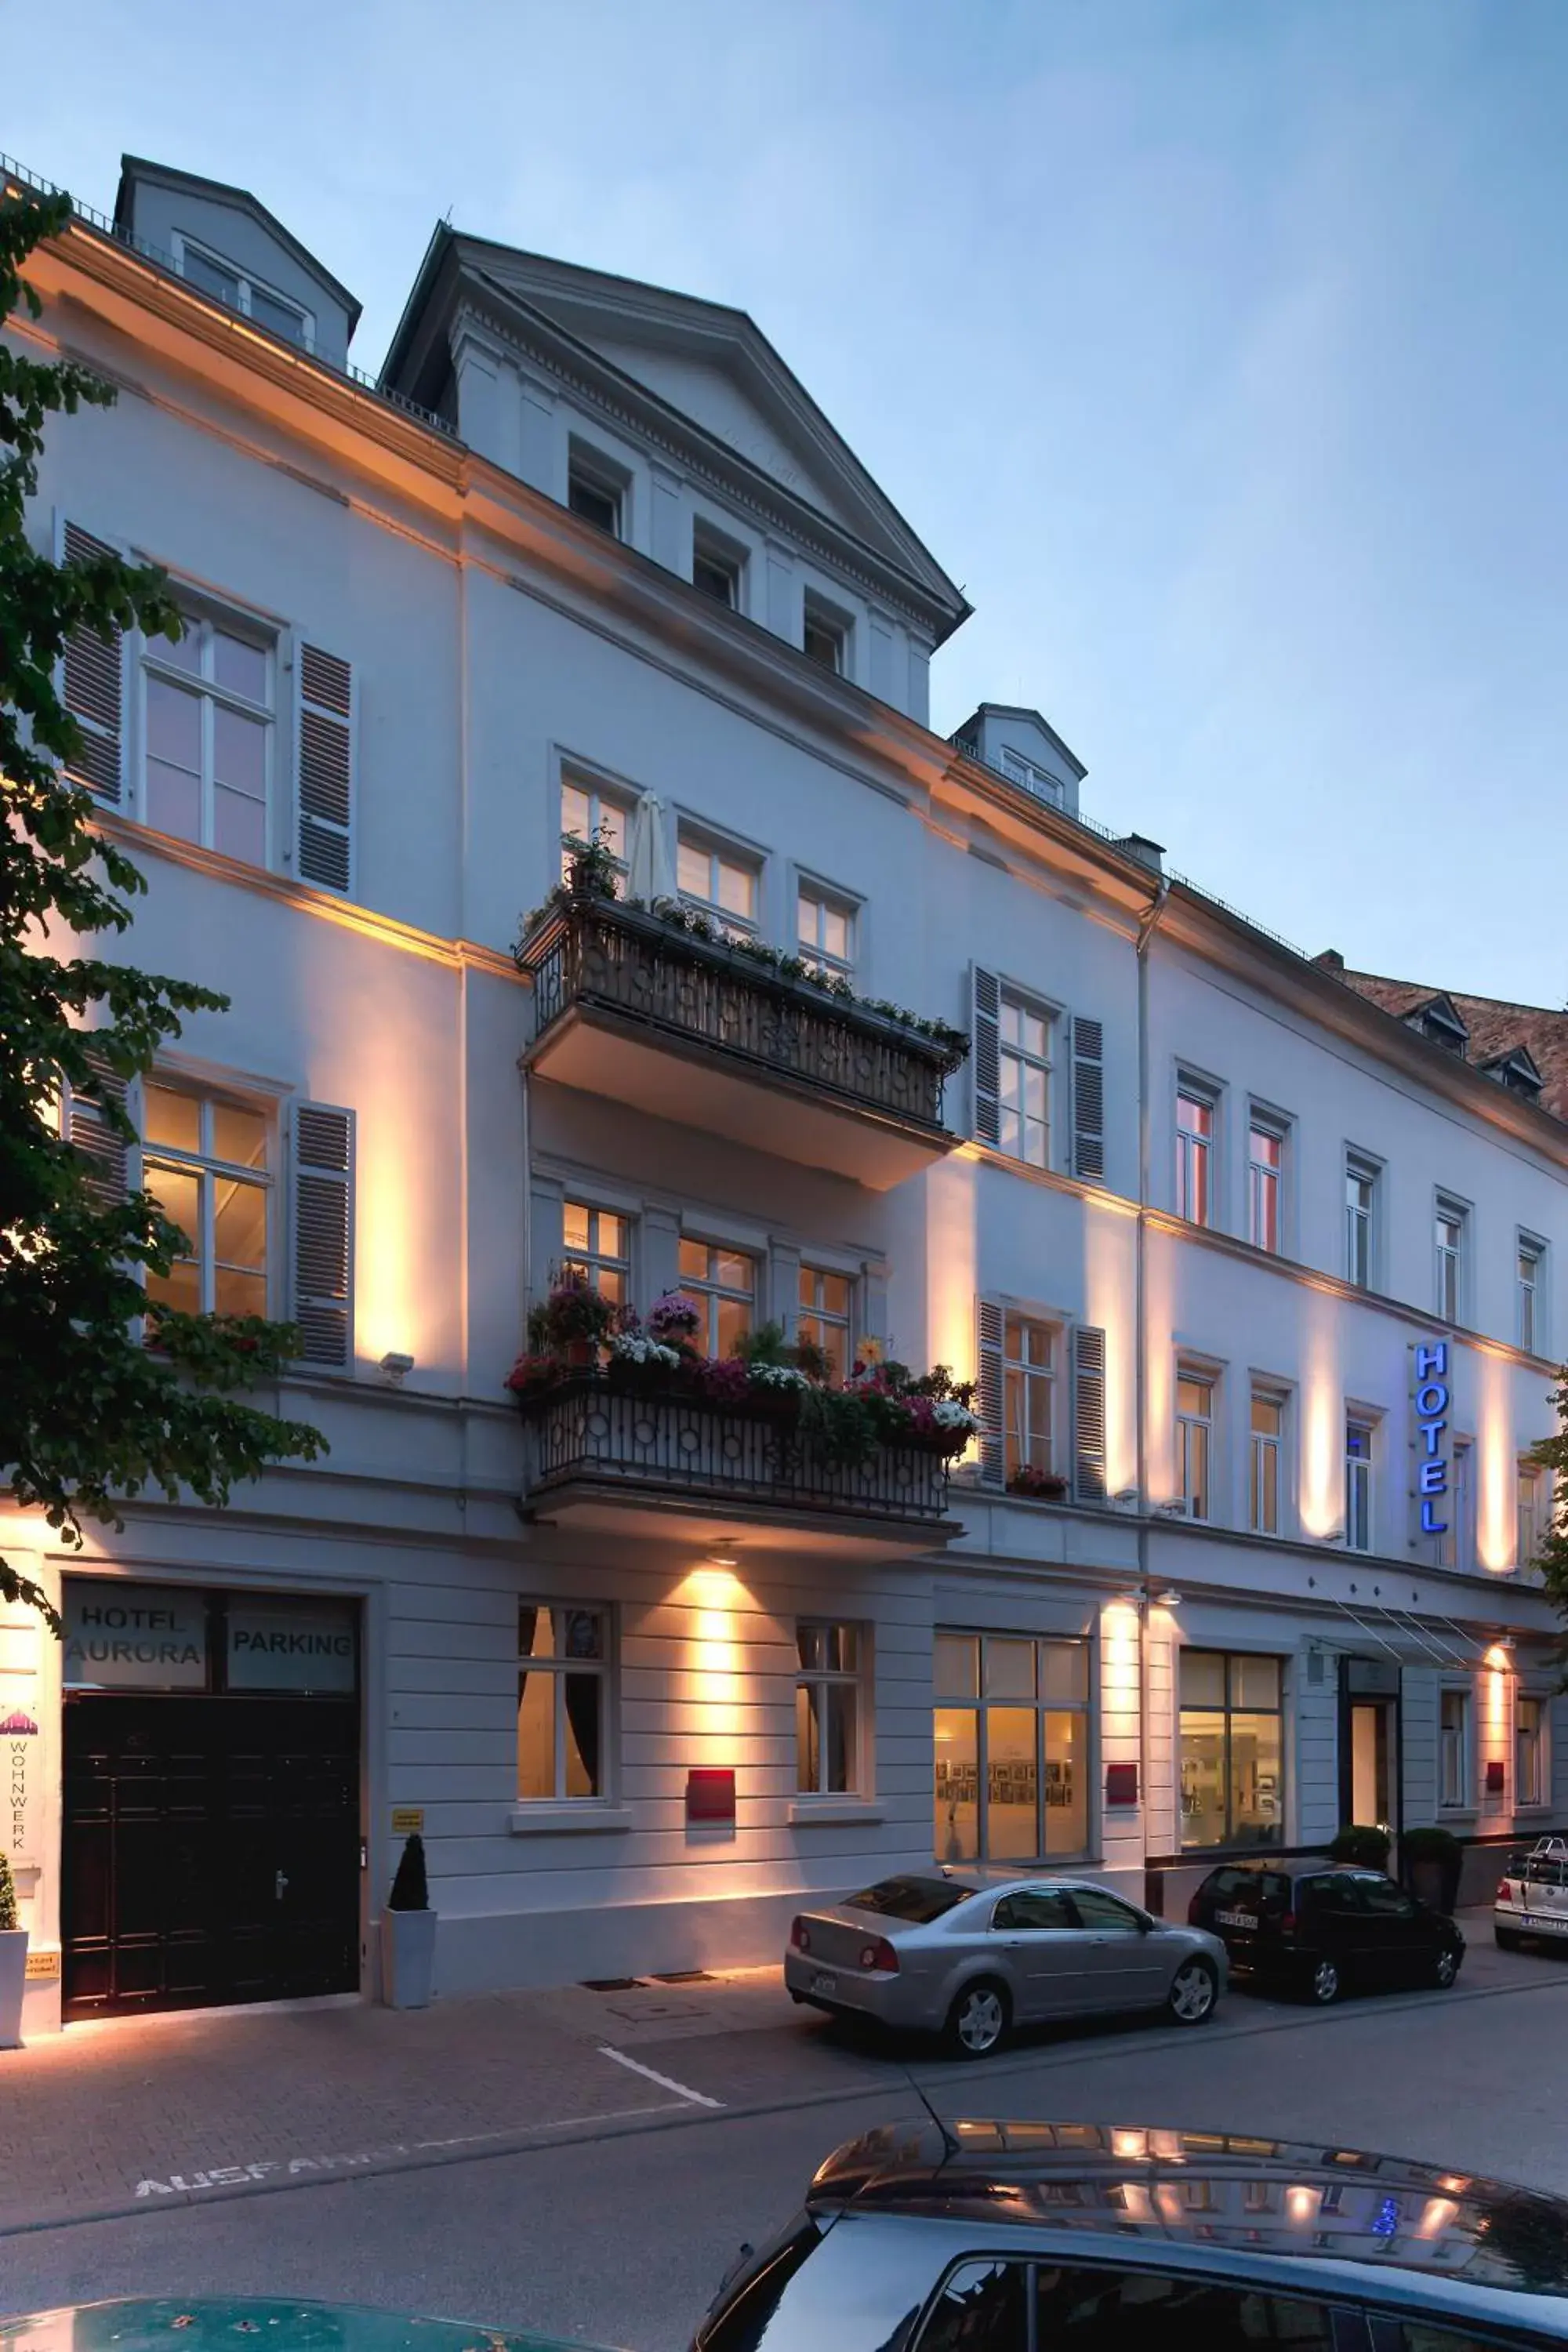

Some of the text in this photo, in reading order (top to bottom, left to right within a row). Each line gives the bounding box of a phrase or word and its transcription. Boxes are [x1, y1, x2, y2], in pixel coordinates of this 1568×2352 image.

[1416, 1342, 1447, 1533] HOTEL
[82, 1606, 187, 1632] HOTEL
[66, 1638, 201, 1664] AURORA
[233, 1630, 352, 1657] PARKING
[9, 1741, 28, 1849] WOHNWERK
[135, 2143, 409, 2198] AUSFA
